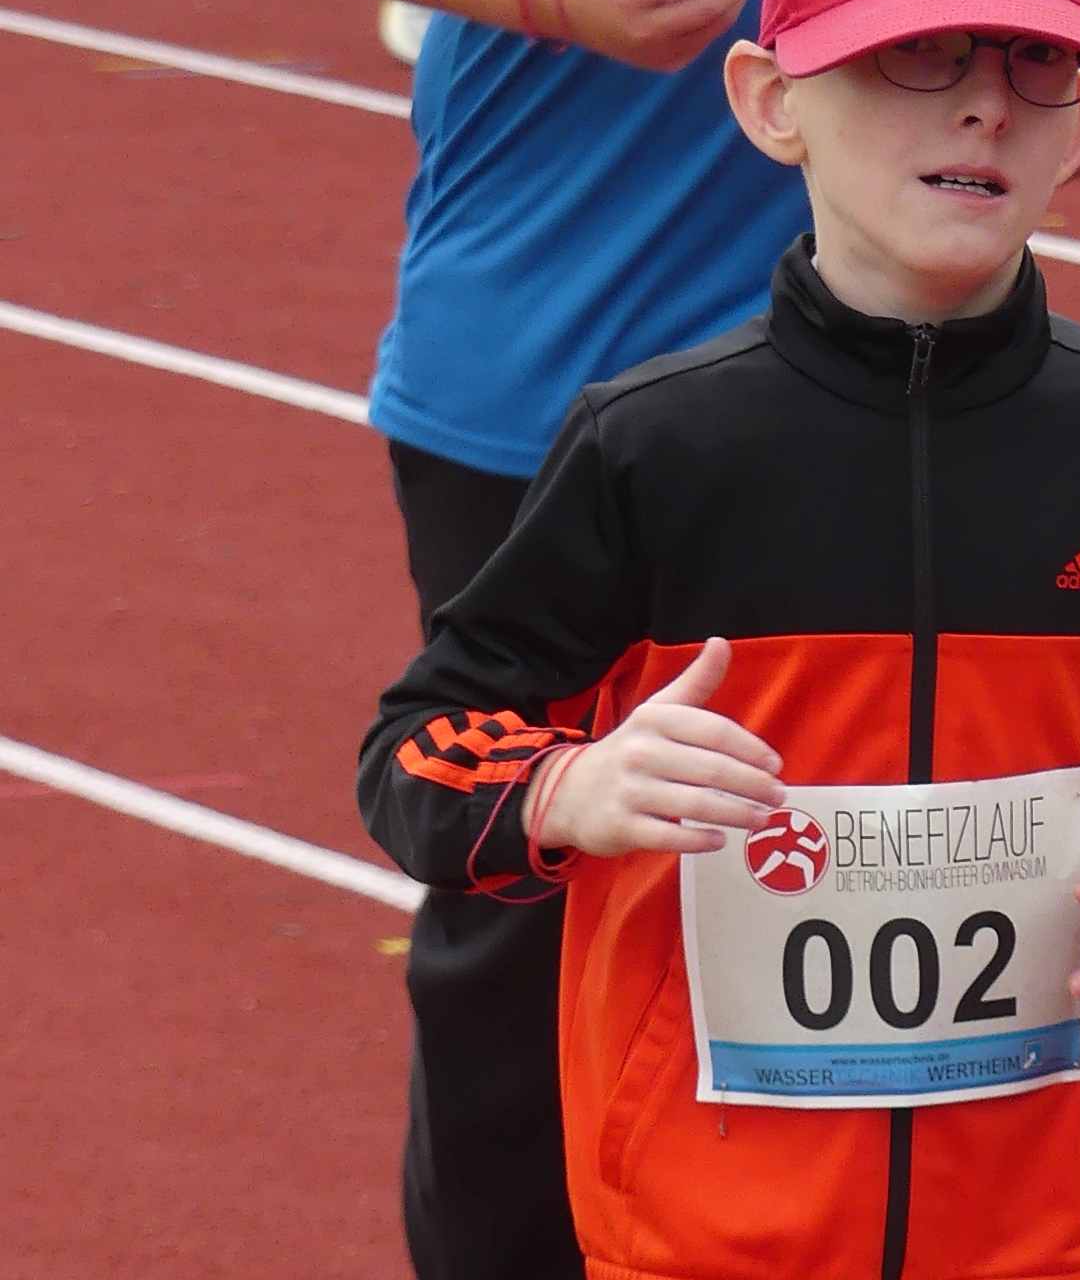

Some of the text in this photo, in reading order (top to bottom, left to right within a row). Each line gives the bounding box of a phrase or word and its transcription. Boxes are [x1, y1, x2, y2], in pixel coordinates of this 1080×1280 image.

[835, 796, 1044, 867] BENEFIZLAUF
[836, 856, 1047, 892] DIETRICH-BONHOEFFER GYMNASIUM
[782, 910, 1017, 1031] 002
[753, 1068, 834, 1086] WASSER
[928, 1056, 1021, 1082] WERTHEIM
